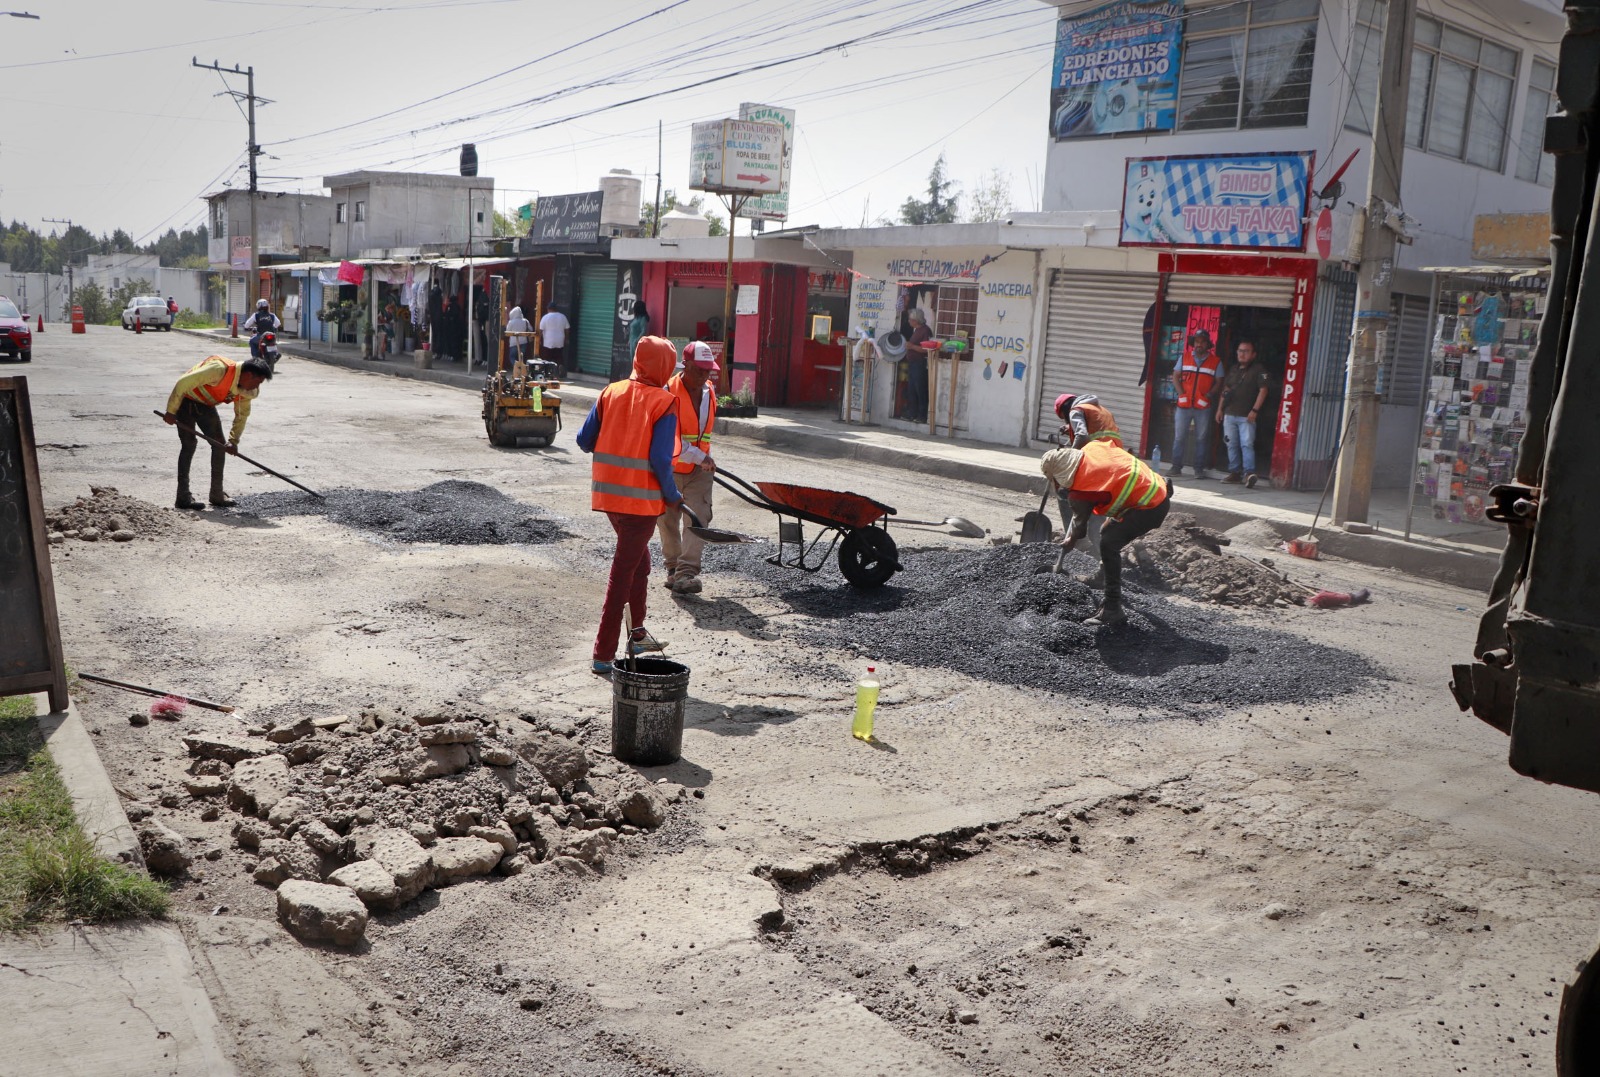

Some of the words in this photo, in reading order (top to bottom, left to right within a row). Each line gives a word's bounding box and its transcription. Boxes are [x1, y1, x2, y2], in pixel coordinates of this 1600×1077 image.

[1071, 32, 1097, 47] Dry
[1062, 41, 1170, 70] EDREDONES
[1059, 58, 1170, 86] PLANCHADO
[730, 122, 755, 133] TIENDA
[756, 125, 765, 134] DE
[726, 140, 763, 151] BLUSAS
[736, 151, 750, 159] ROPA
[750, 152, 758, 160] DE
[743, 161, 779, 171] PANTALONES
[1140, 164, 1149, 178] B
[1218, 173, 1272, 192] BIMBO
[1182, 205, 1298, 234] TUKI-TAKA
[673, 262, 716, 277] CARNICERIA
[890, 259, 941, 277] MERCERIA
[859, 292, 882, 300] BOTONES
[984, 283, 1032, 298] JARCERIA
[997, 310, 1006, 322] Y
[1292, 278, 1308, 345] MINI
[980, 335, 1026, 353] COPIAS
[1279, 351, 1299, 434] SUPER
